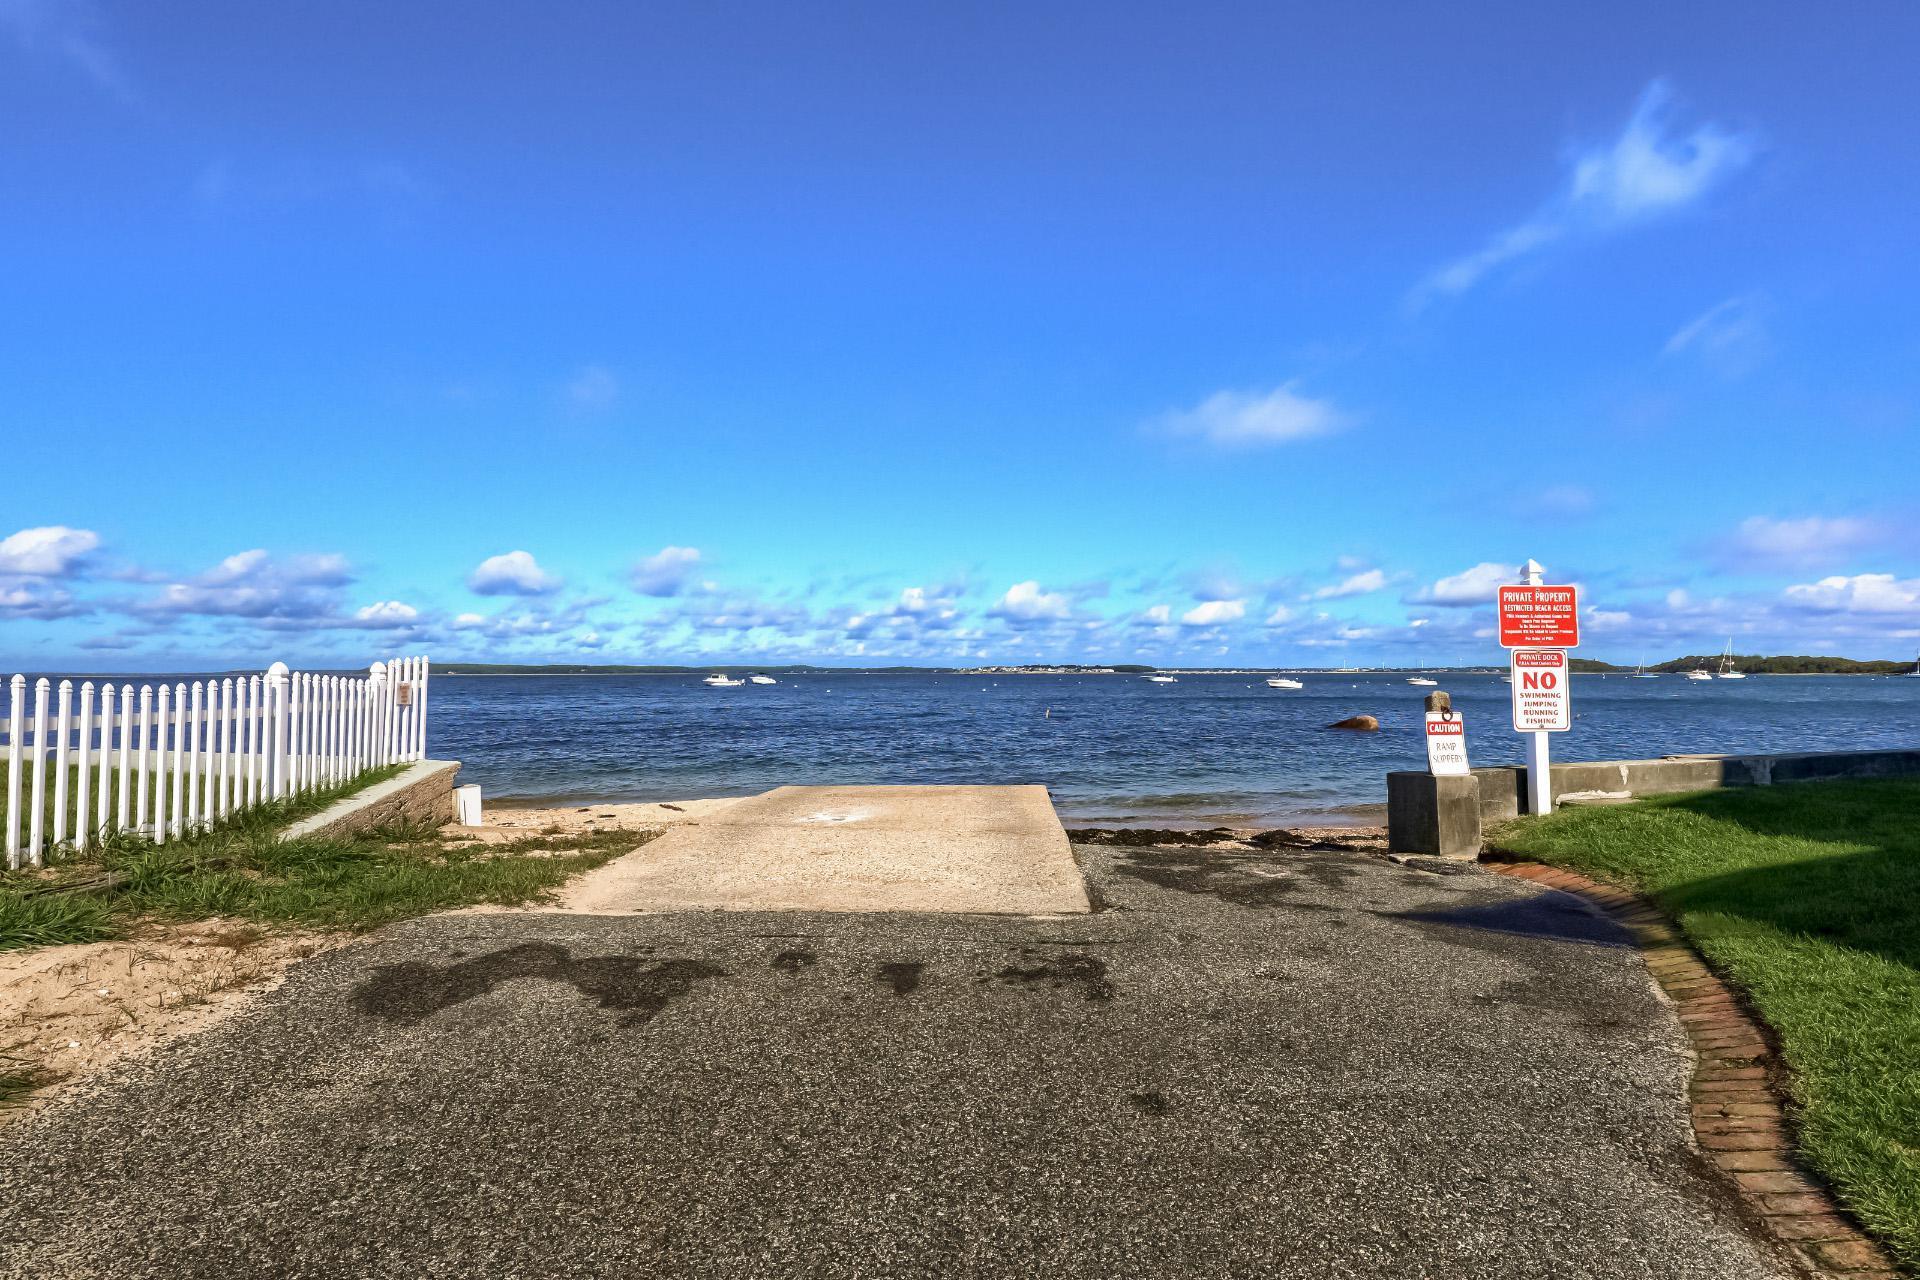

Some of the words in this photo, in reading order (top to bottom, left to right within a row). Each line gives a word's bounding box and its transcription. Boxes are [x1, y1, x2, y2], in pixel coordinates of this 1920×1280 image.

[1504, 592, 1532, 602] PRIVATE
[1536, 592, 1570, 602] PROPERTY
[1523, 672, 1556, 690] NO
[1429, 724, 1460, 732] CAUTION
[1436, 742, 1456, 751] RAMP
